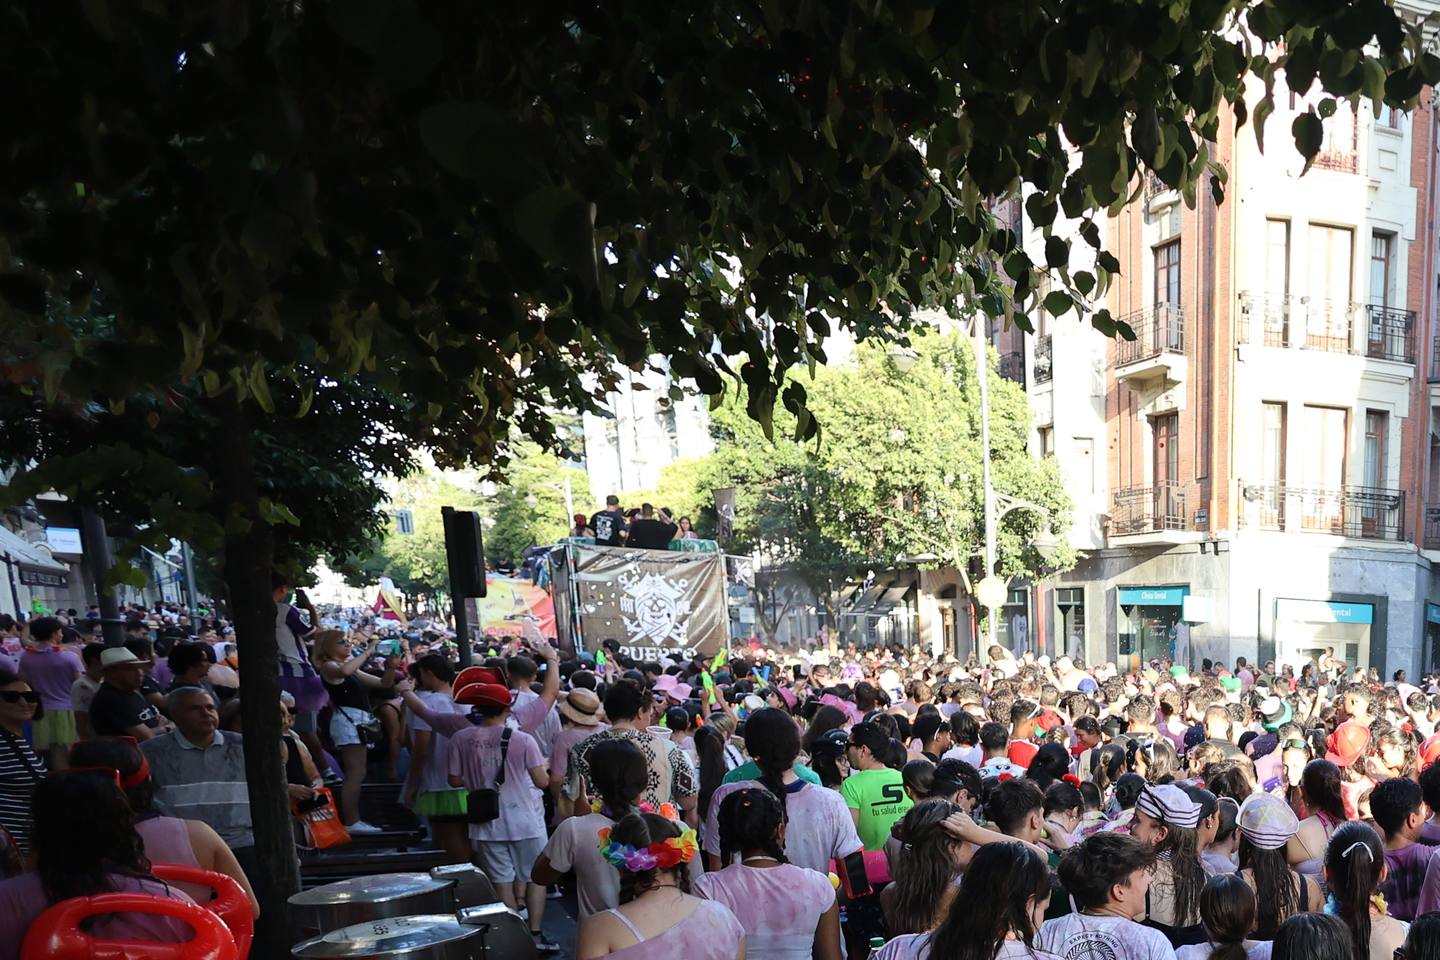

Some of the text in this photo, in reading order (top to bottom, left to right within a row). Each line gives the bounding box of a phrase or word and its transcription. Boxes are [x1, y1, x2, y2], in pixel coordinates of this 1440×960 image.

[881, 805, 897, 815] salud
[1069, 933, 1119, 949] EXPECT NOTHING
